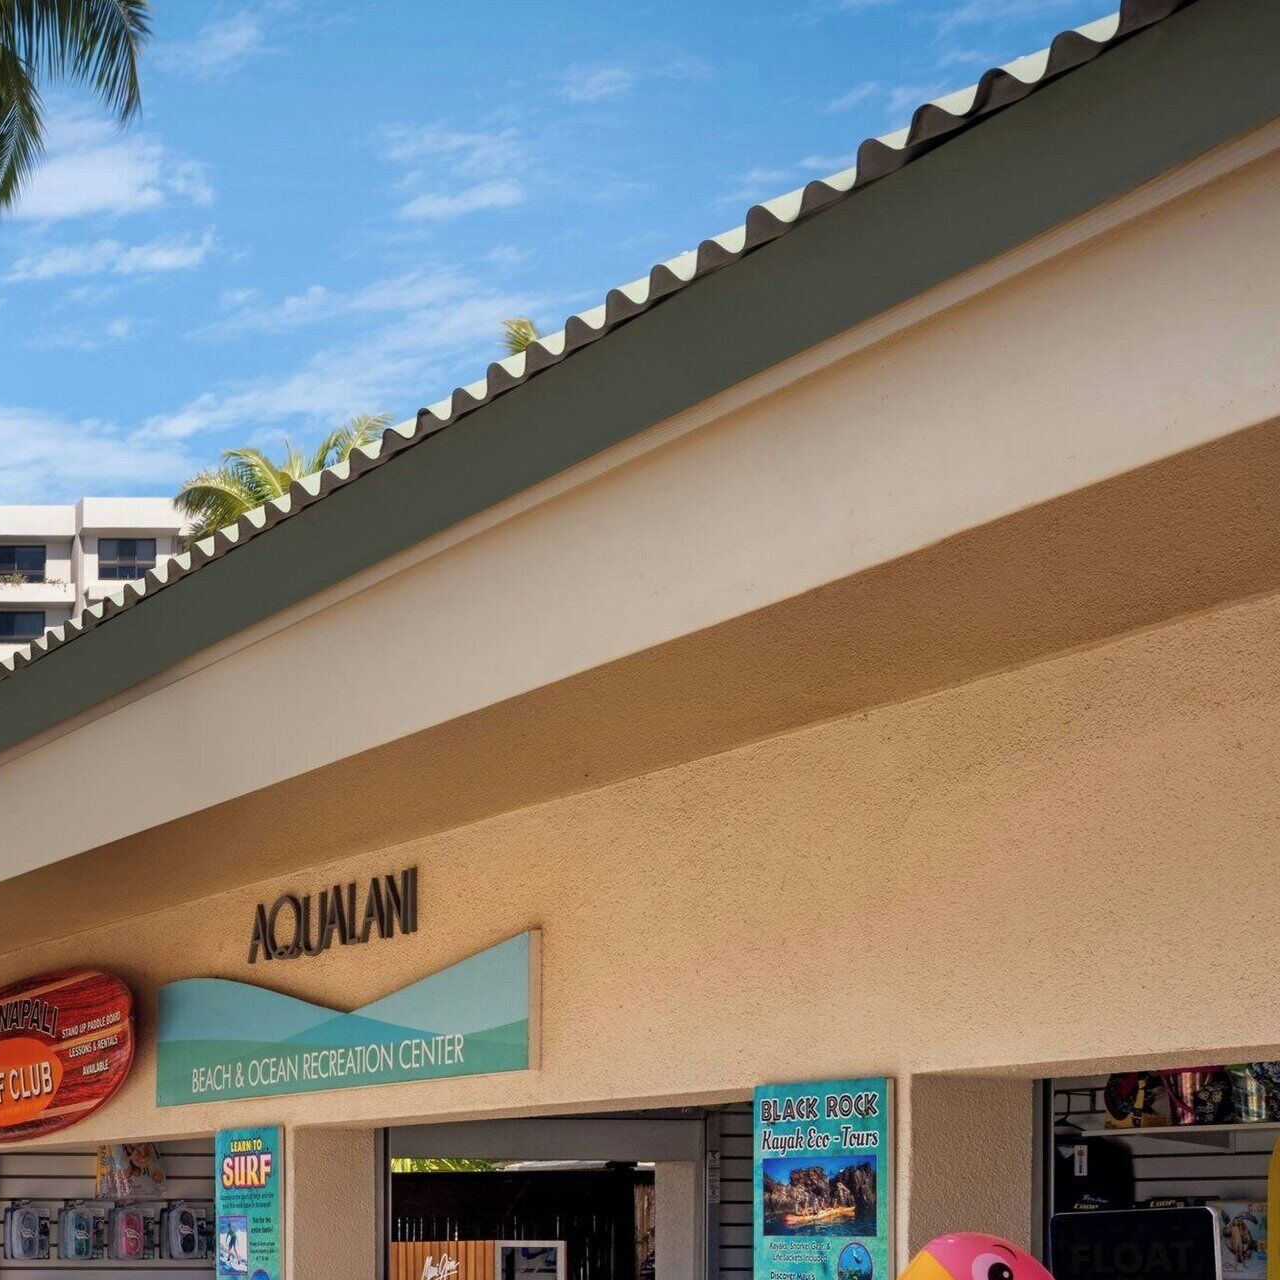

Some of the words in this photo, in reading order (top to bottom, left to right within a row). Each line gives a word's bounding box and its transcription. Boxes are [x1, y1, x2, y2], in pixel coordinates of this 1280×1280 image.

[247, 867, 418, 964] AQUALANI
[61, 1025, 78, 1039] STAND
[80, 1022, 87, 1033] UP
[87, 1017, 105, 1031] PADDLE
[106, 1011, 121, 1025] BOARD
[69, 1042, 92, 1058] LESSONS
[97, 1035, 118, 1050] RENTALS
[82, 1059, 109, 1076] AVAILABLE
[192, 1063, 232, 1093] BEACH
[235, 1062, 245, 1088] &
[248, 1055, 299, 1087] OCEAN
[302, 1042, 394, 1080] RECREATION
[399, 1034, 465, 1070] CENTER
[9, 1061, 54, 1100] CLUB
[761, 1097, 819, 1122] BLACK
[826, 1092, 878, 1118] ROCK
[230, 1140, 251, 1153] LEARN
[252, 1139, 262, 1150] TO
[762, 1127, 805, 1155] Kayak
[807, 1128, 831, 1149] Eco
[842, 1125, 878, 1148] Tours
[222, 1153, 272, 1189] SURF
[811, 1243, 824, 1251] Gear
[1070, 1241, 1197, 1275] FLOAT
[771, 1271, 795, 1280] Discover
[797, 1272, 816, 1280] Maui's
